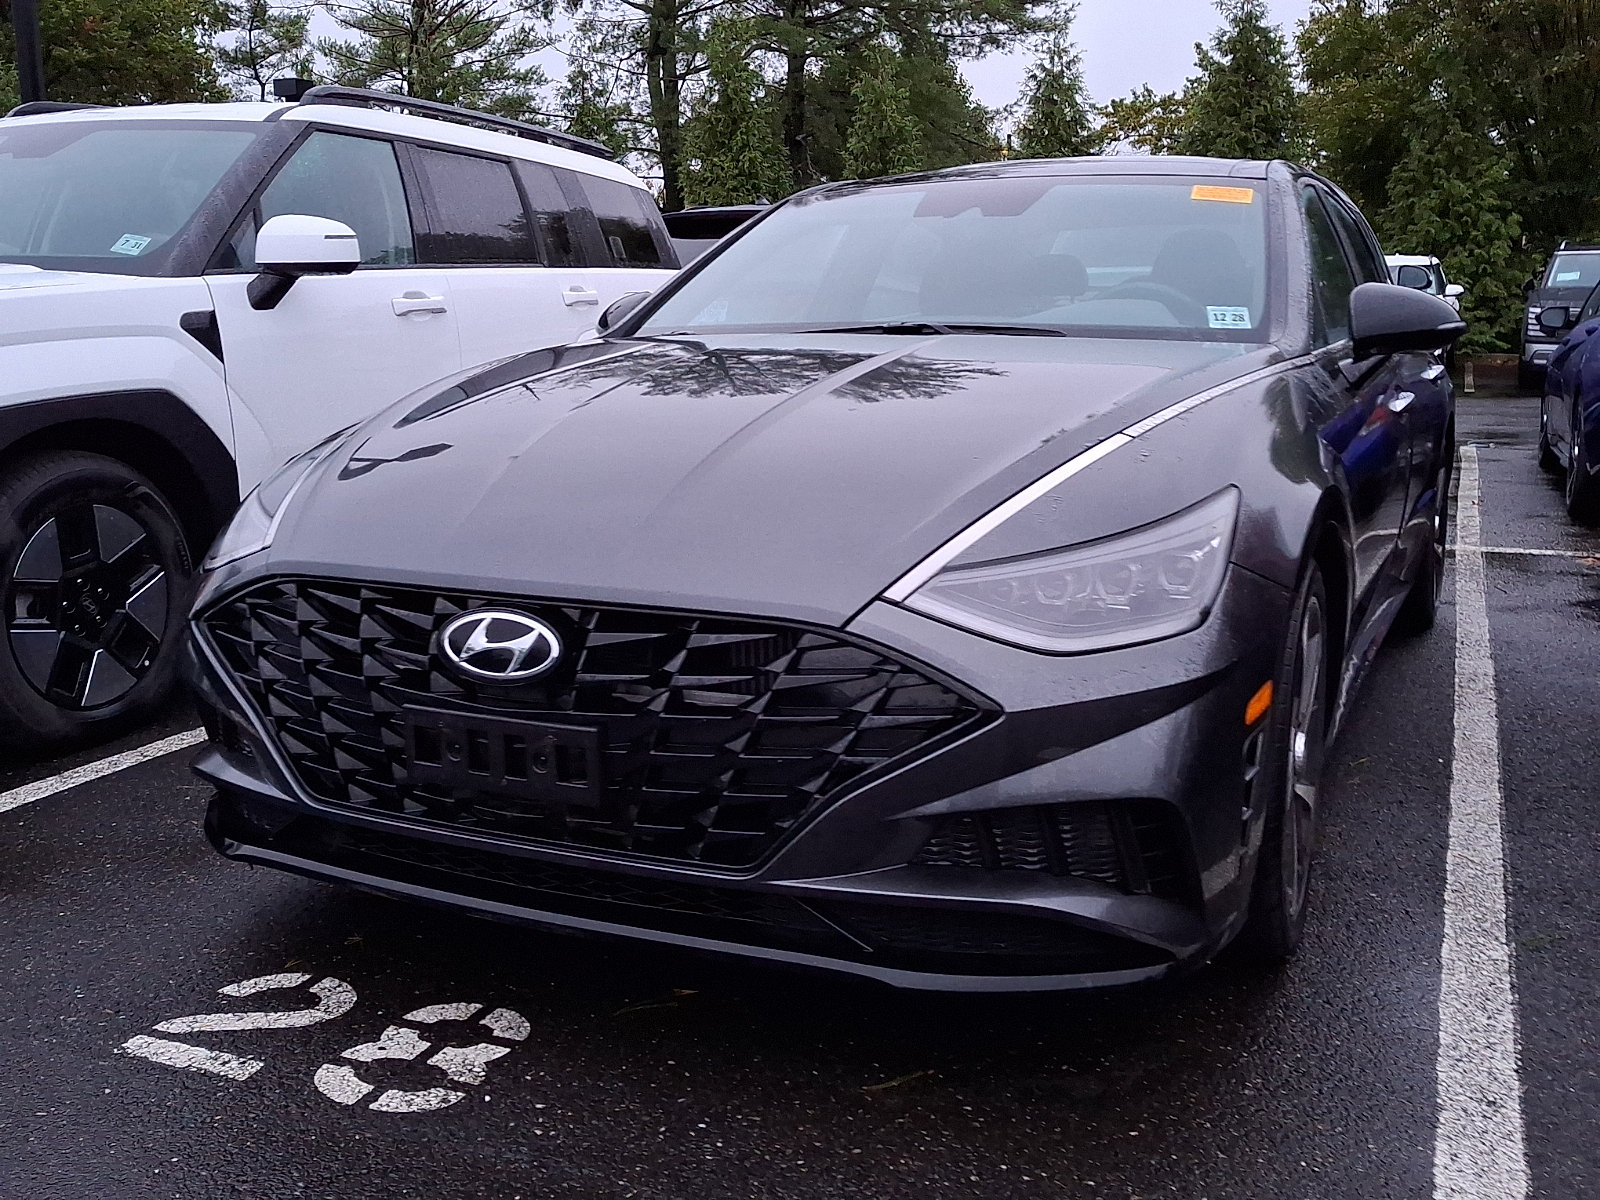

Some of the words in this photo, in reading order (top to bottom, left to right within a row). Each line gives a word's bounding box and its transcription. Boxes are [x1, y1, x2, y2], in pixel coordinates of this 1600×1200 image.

[121, 239, 130, 247] 7
[1213, 312, 1227, 322] 12
[1231, 313, 1246, 322] 28
[118, 972, 532, 1113] 28
